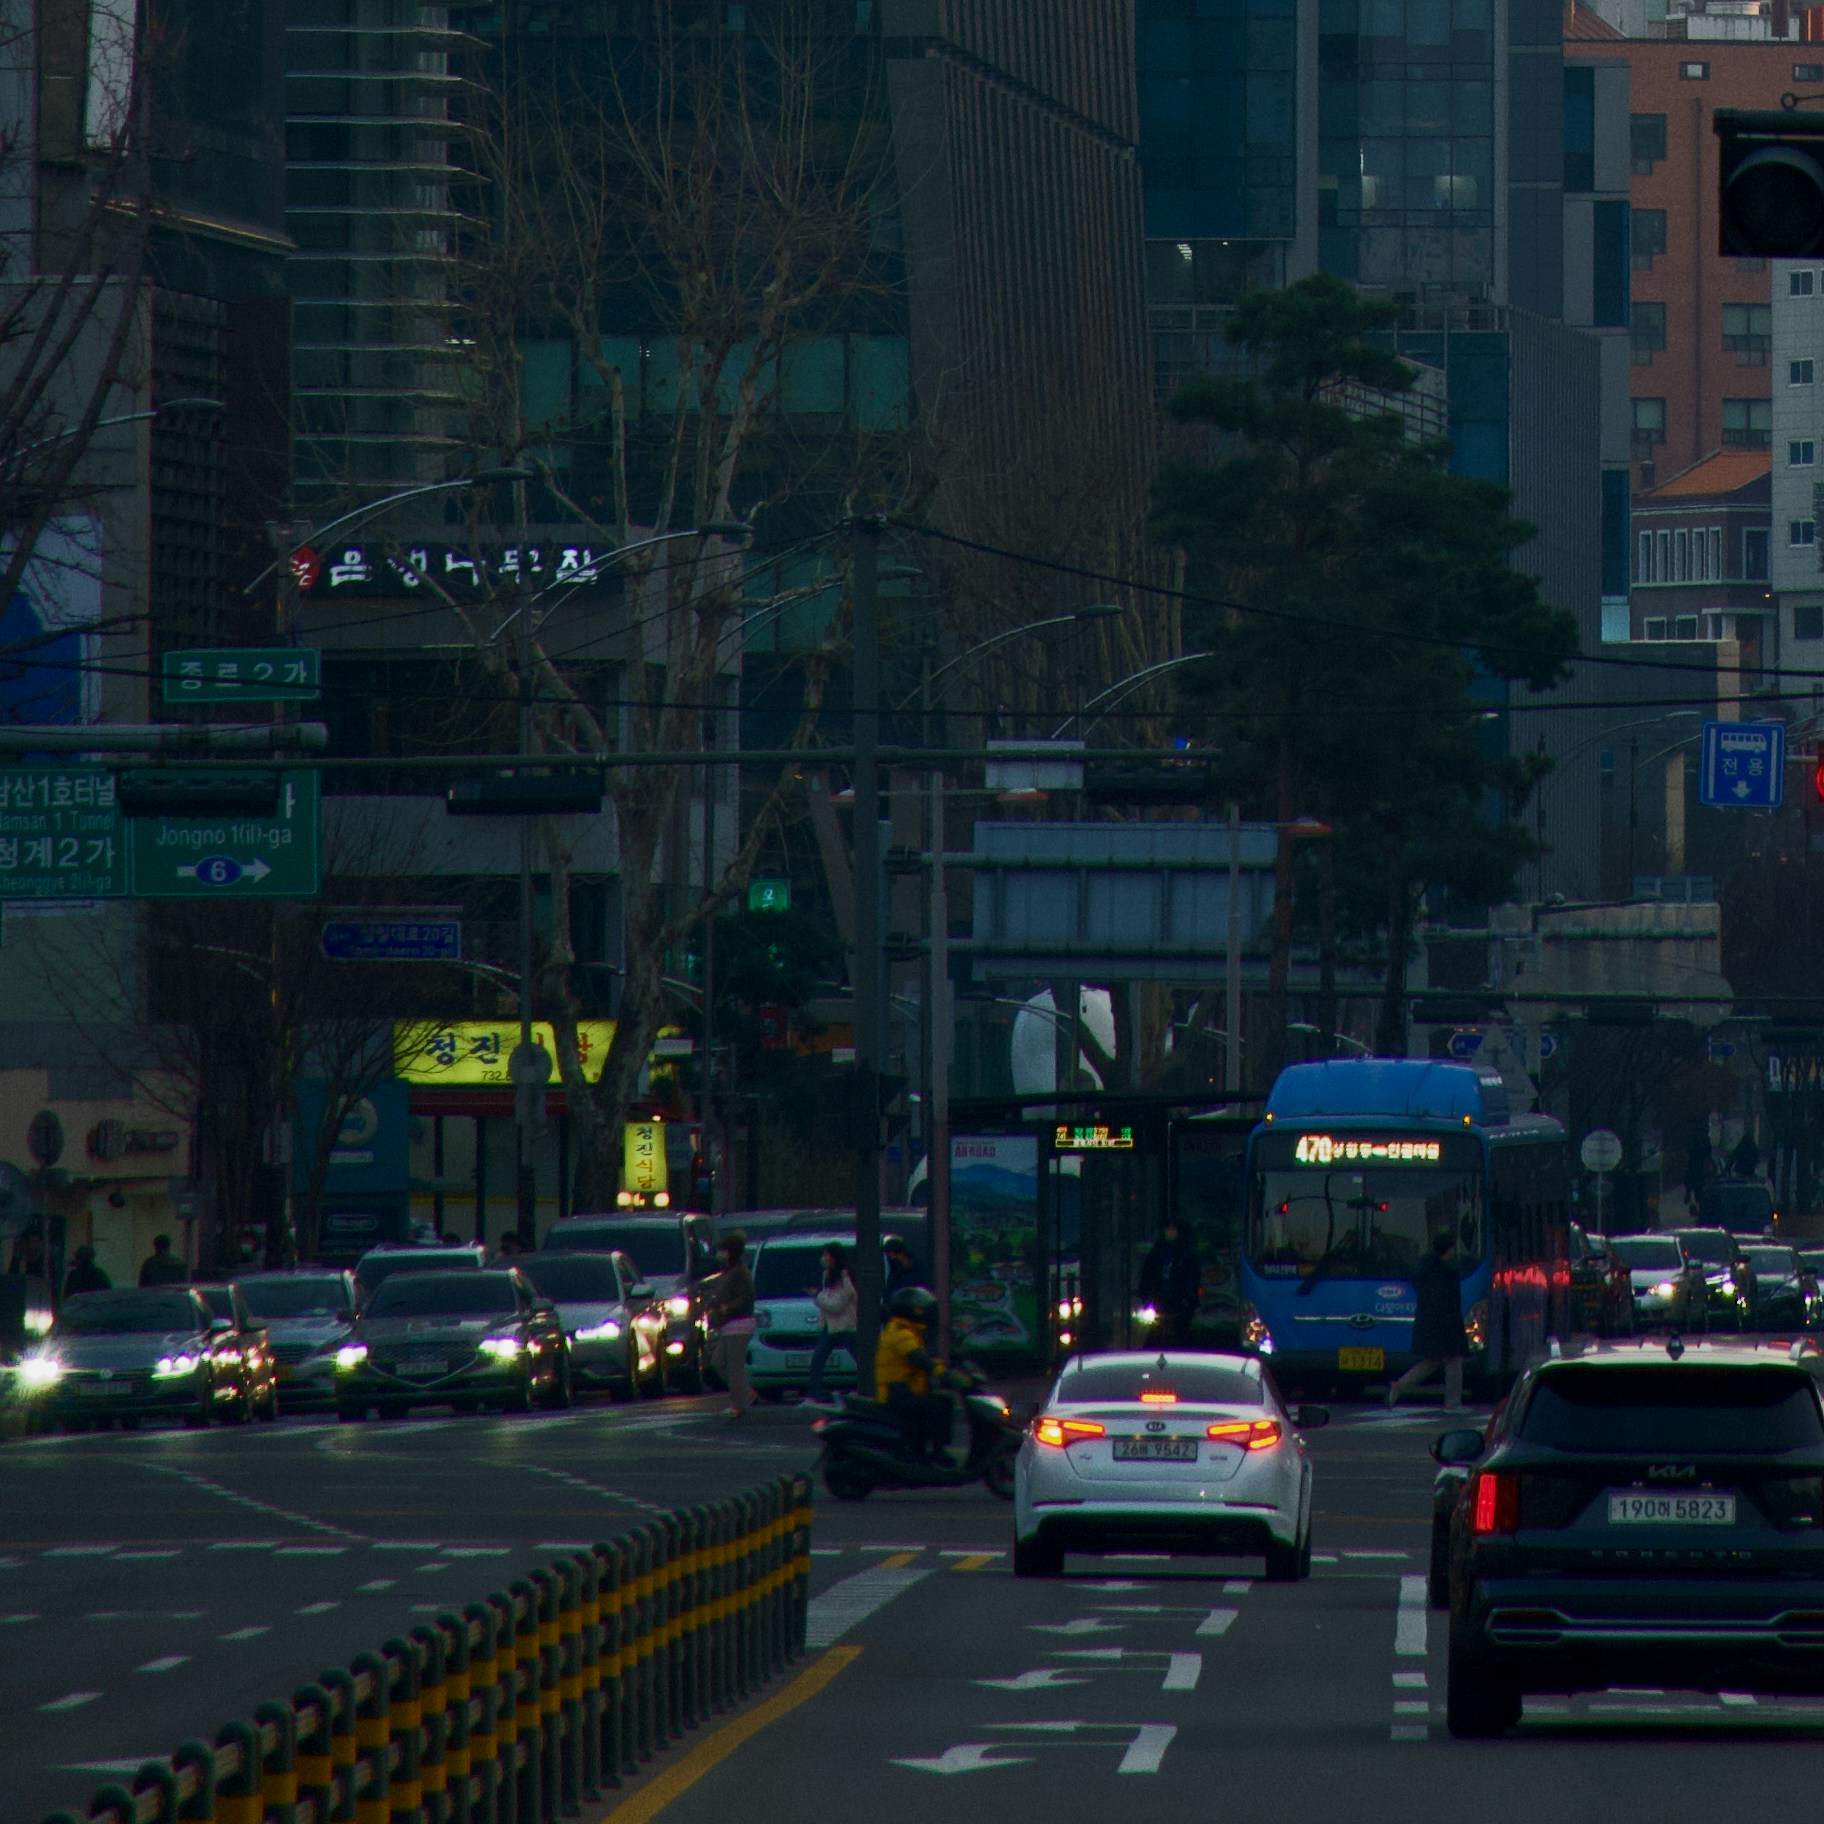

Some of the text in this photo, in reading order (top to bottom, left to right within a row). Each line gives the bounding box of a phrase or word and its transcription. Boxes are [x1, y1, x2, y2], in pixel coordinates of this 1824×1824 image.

[1722, 756, 1765, 776] 전용
[0, 812, 47, 831] amsan
[71, 810, 115, 830] Tunnel
[156, 823, 293, 850] Jongno 1(il)-ga
[211, 860, 228, 882] 6
[1296, 1135, 1332, 1163] 470
[1154, 1442, 1190, 1457] 9542
[1675, 1500, 1727, 1519] 5823
